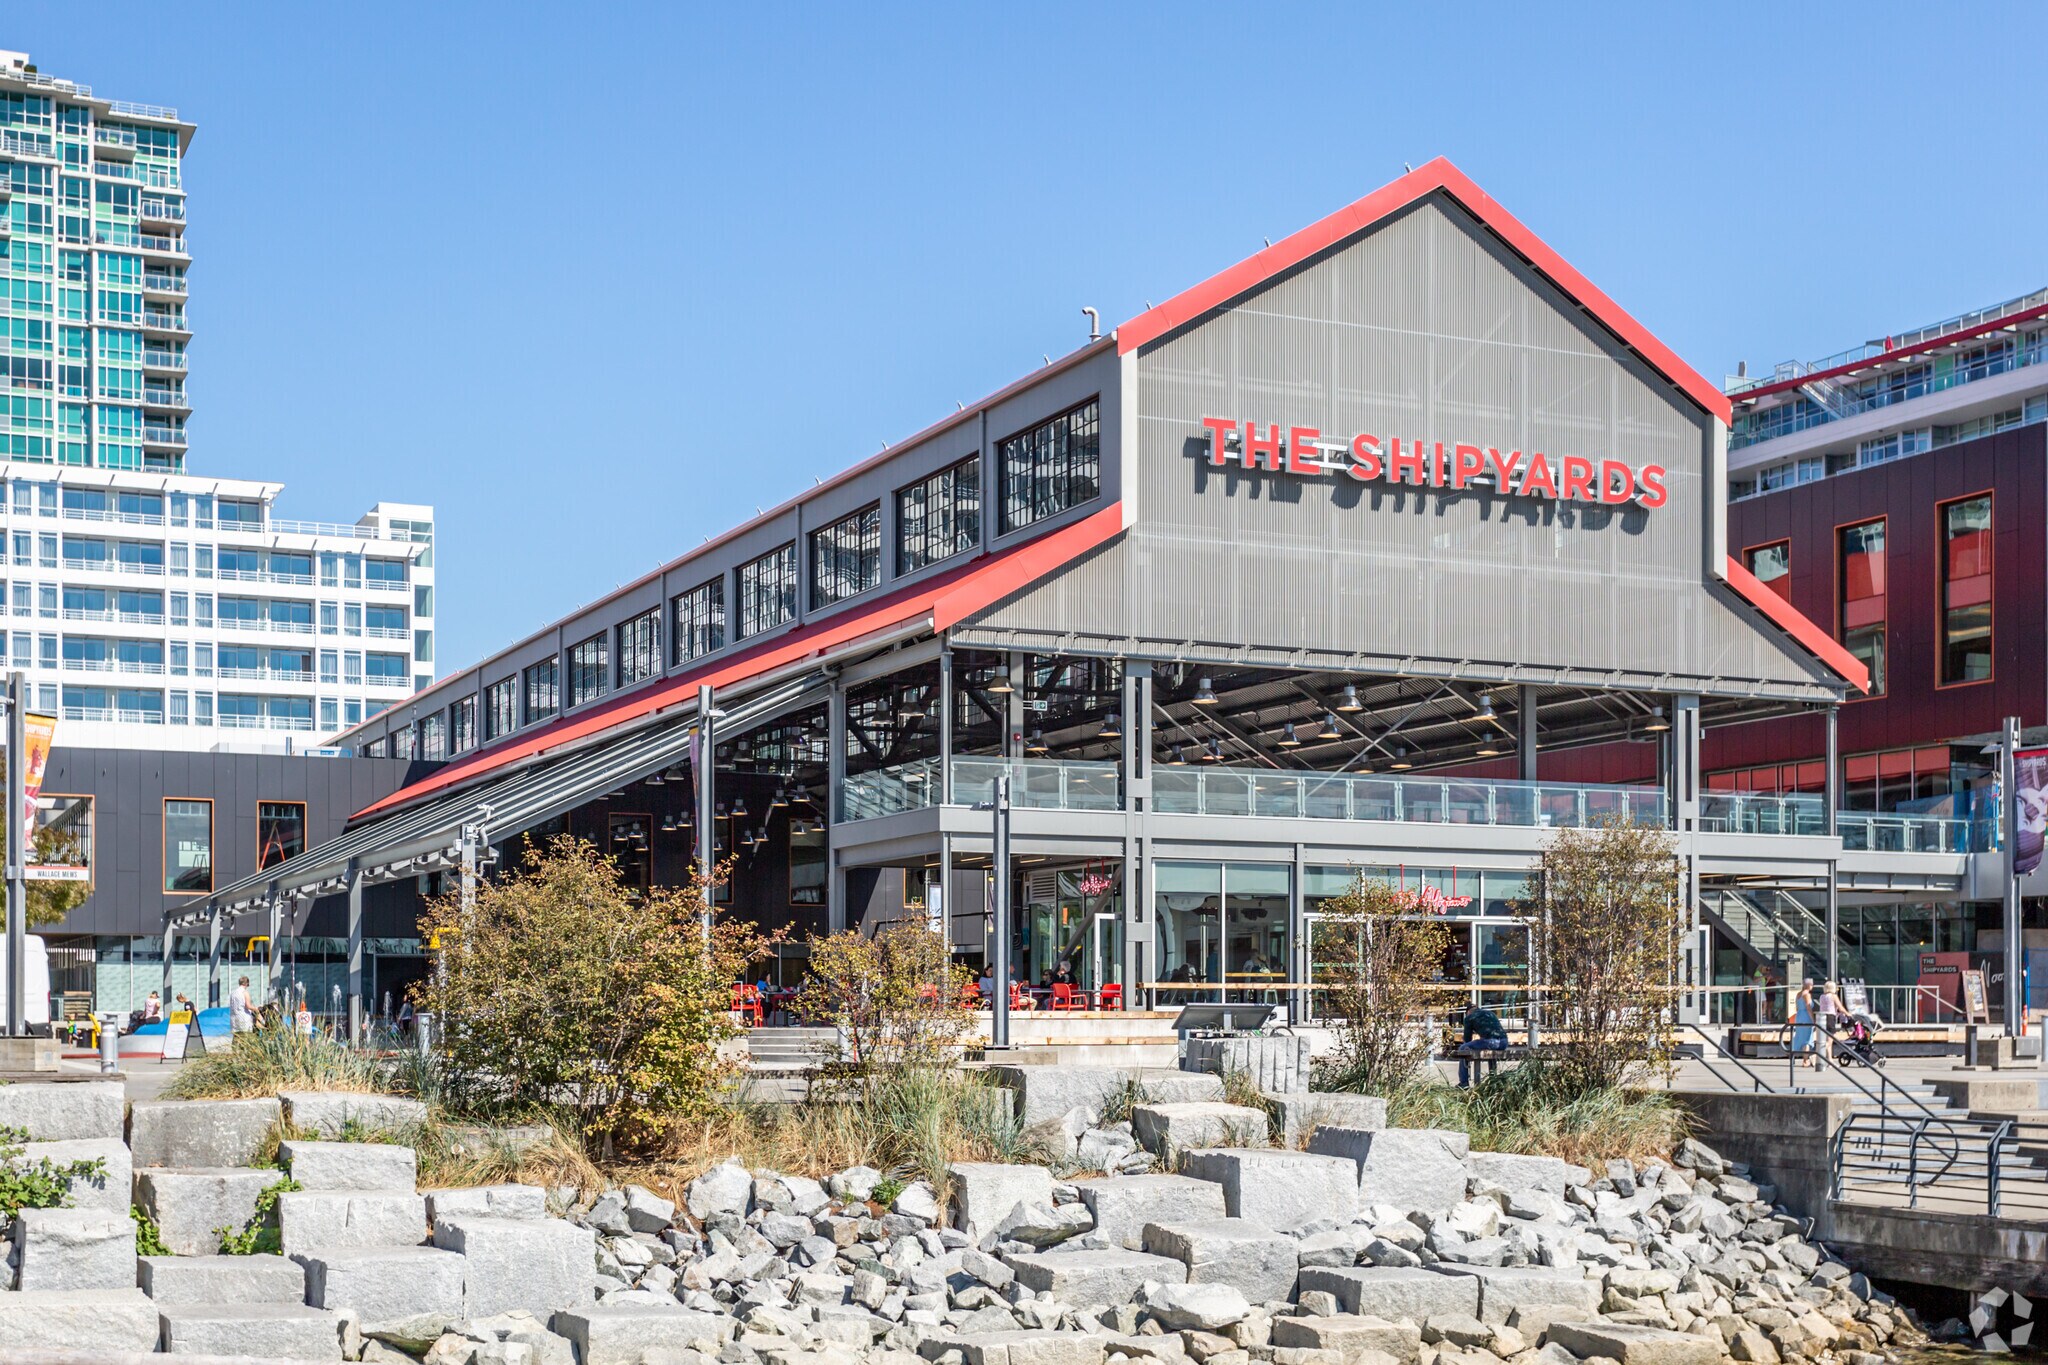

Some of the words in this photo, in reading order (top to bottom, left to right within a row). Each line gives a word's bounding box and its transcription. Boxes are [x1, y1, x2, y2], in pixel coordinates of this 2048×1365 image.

[1201, 416, 1320, 476] THE
[1345, 433, 1668, 510] SHIPYARDS
[37, 870, 60, 878] WALLACE
[62, 870, 78, 878] MEWS
